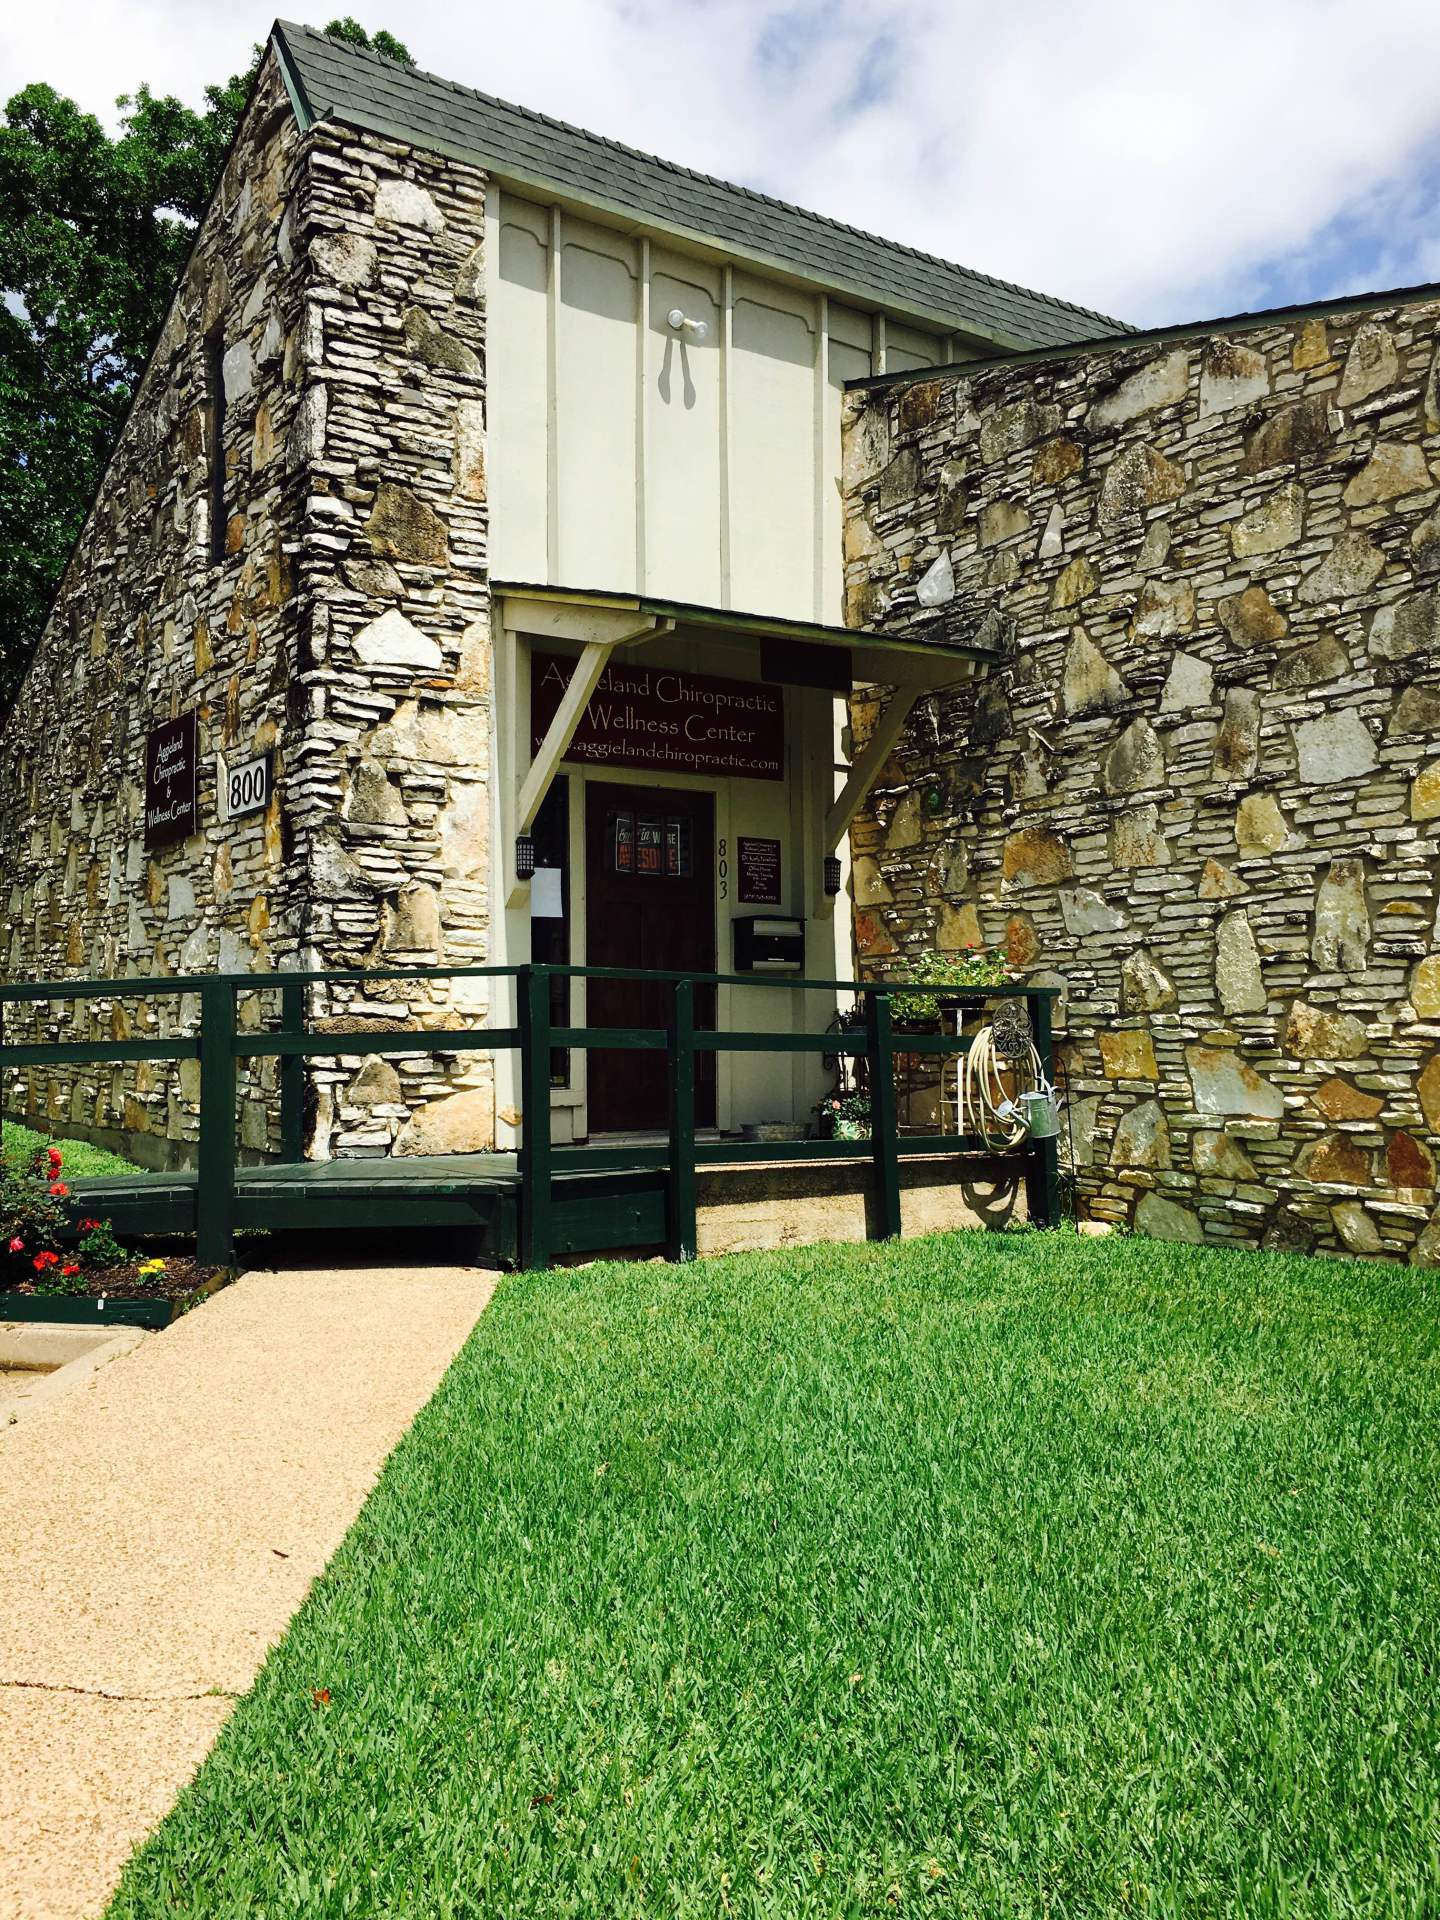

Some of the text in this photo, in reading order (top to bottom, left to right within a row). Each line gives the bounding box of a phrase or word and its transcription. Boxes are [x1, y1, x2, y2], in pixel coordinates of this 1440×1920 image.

[540, 661, 777, 714] Aeland Chiropractic
[587, 702, 756, 743] Wellness Center
[535, 736, 779, 770] w.aggielandchiropractic.com
[230, 765, 264, 810] 800
[170, 800, 192, 820] Center
[718, 838, 728, 900] 803
